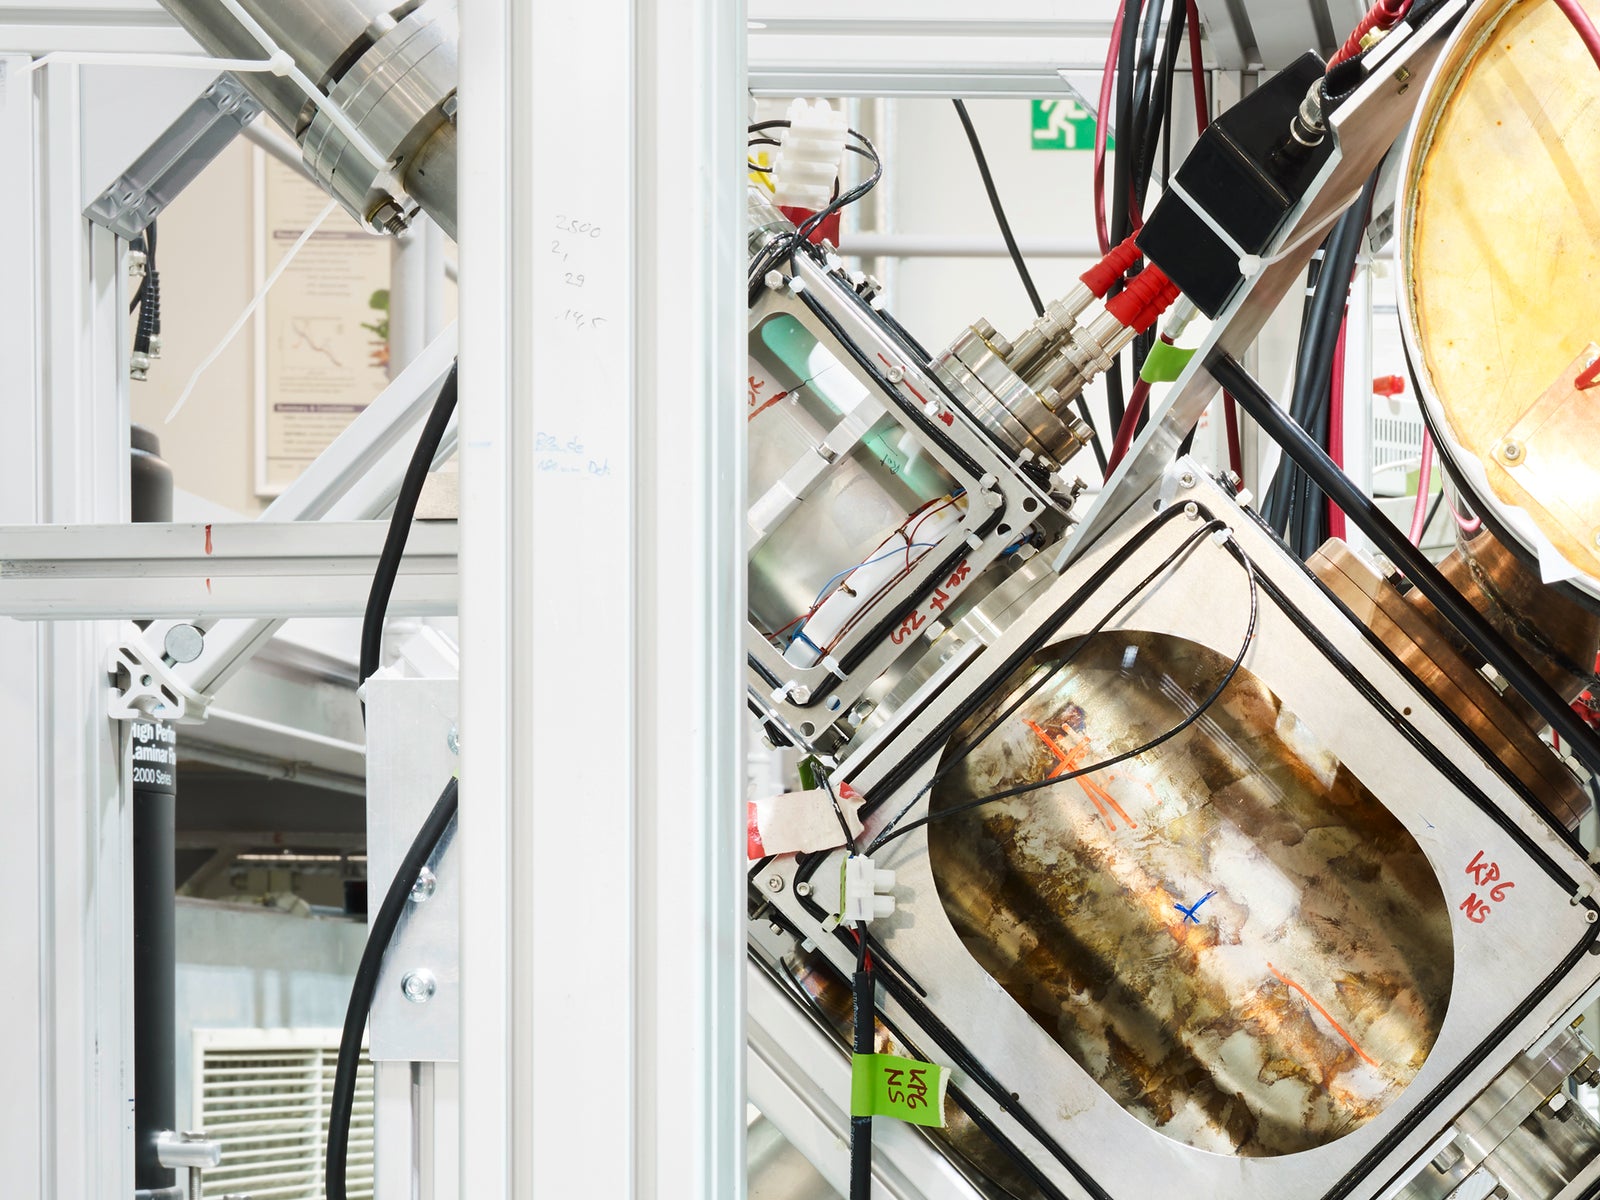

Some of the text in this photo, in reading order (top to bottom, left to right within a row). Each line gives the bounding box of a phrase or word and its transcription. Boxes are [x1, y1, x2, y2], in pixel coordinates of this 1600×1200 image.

[132, 744, 168, 764] aminar
[133, 767, 155, 784] 2000
[1465, 850, 1516, 903] KP6
[1459, 892, 1492, 925] NS
[883, 1067, 906, 1104] NS
[905, 1067, 929, 1110] KP6
